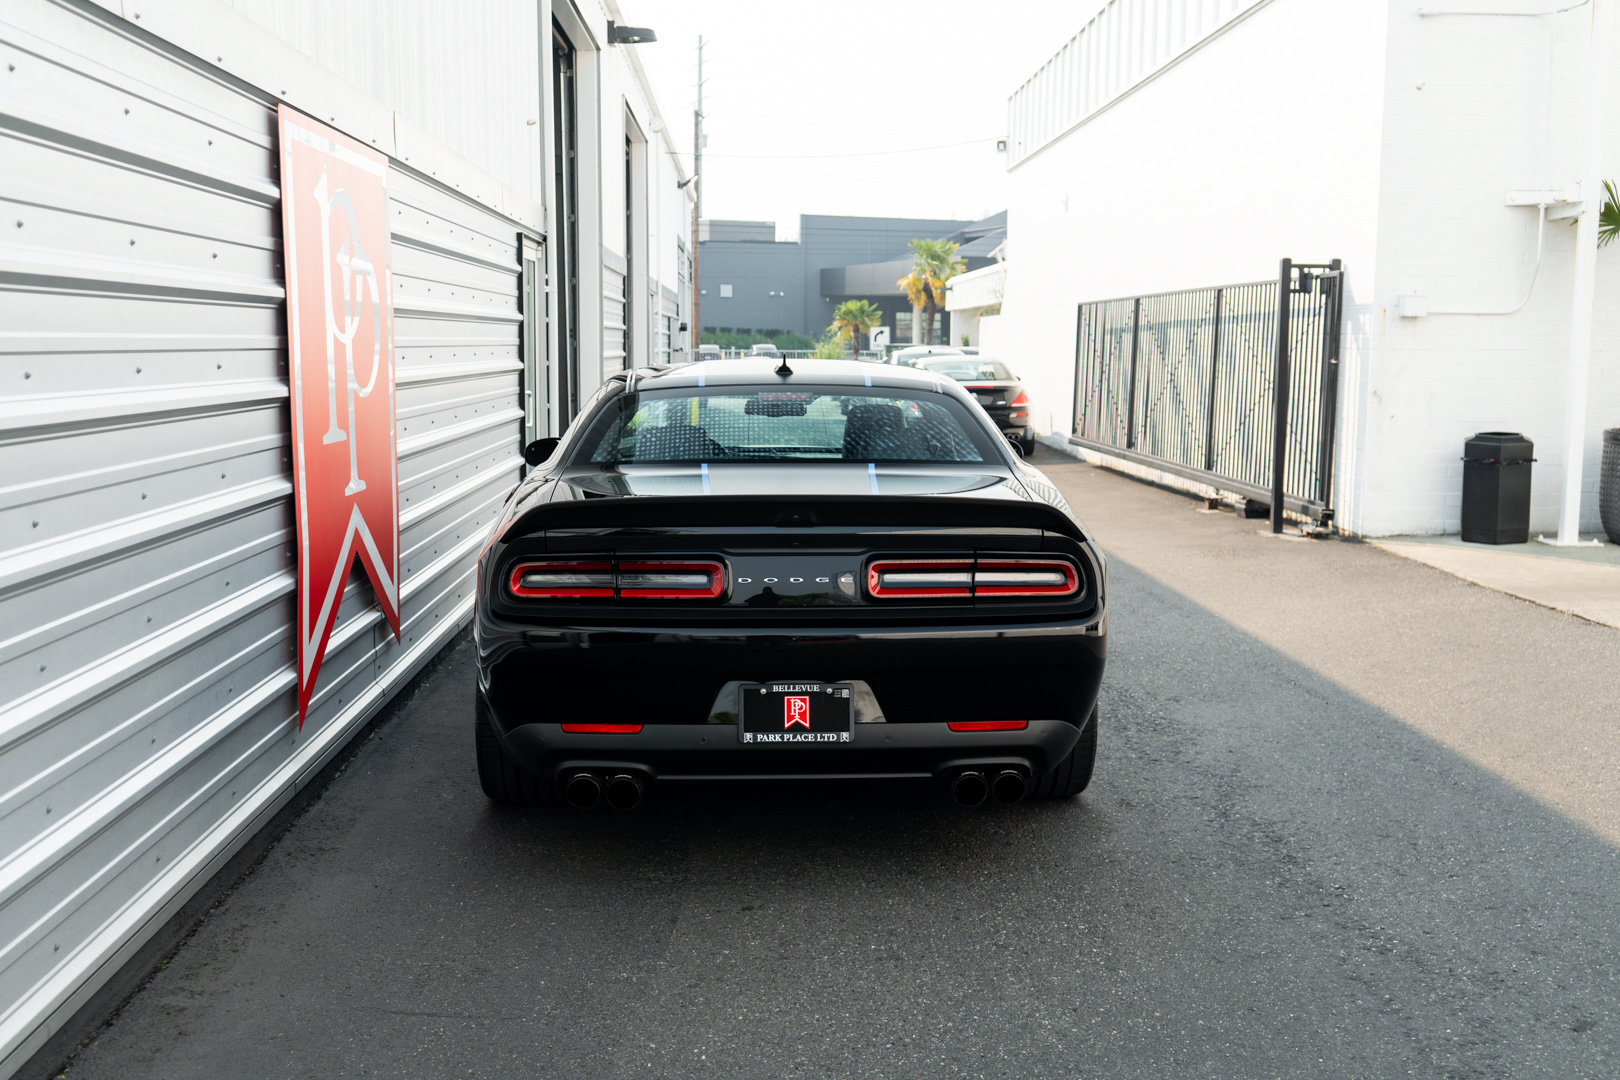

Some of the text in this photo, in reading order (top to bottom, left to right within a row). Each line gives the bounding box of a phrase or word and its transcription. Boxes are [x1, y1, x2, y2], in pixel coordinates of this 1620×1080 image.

[757, 734, 782, 742] PARK
[783, 734, 815, 742] PLACE
[817, 733, 837, 741] LTD
